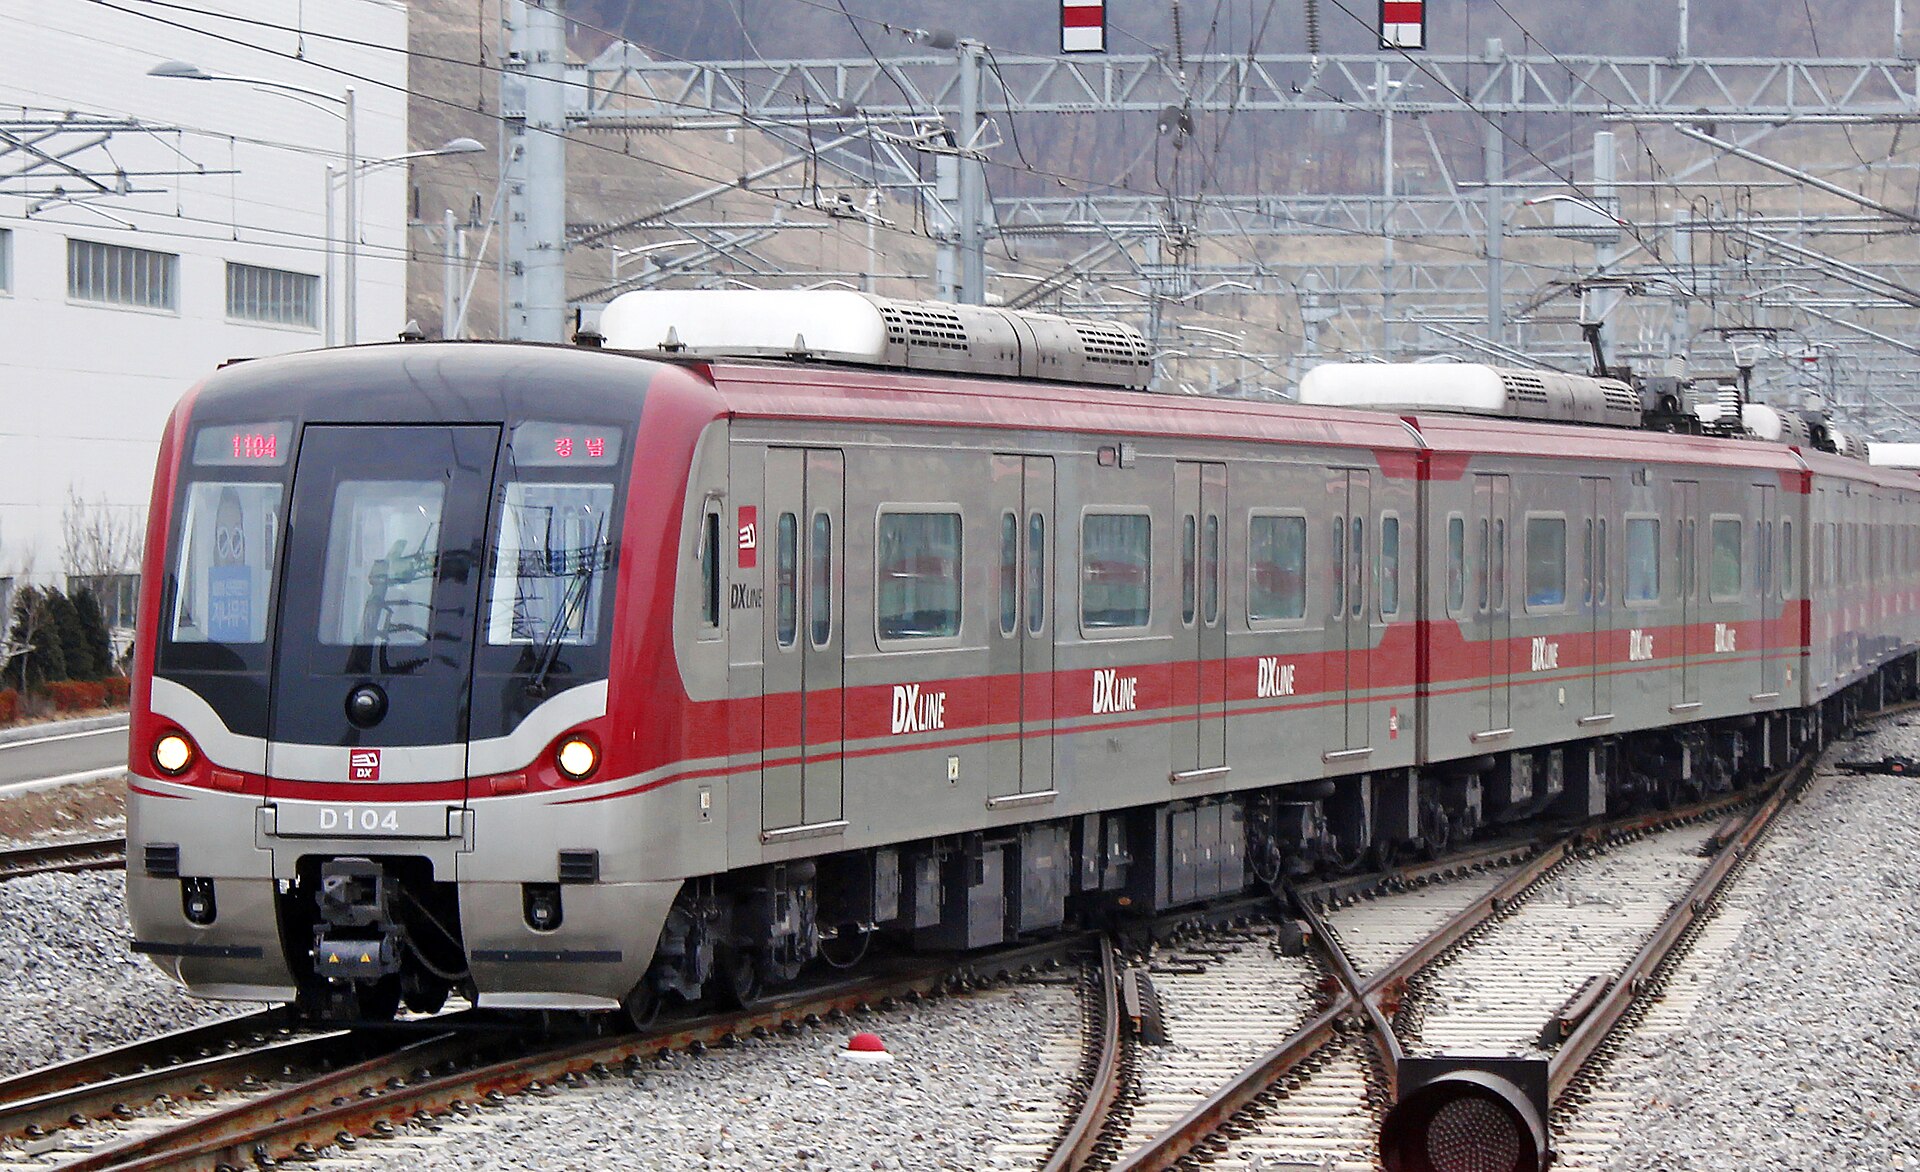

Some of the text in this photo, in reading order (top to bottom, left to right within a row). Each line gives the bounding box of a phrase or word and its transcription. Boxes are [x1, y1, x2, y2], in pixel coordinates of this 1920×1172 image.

[232, 433, 277, 459] 1104
[356, 767, 373, 778] DX
[320, 808, 399, 831] D104
